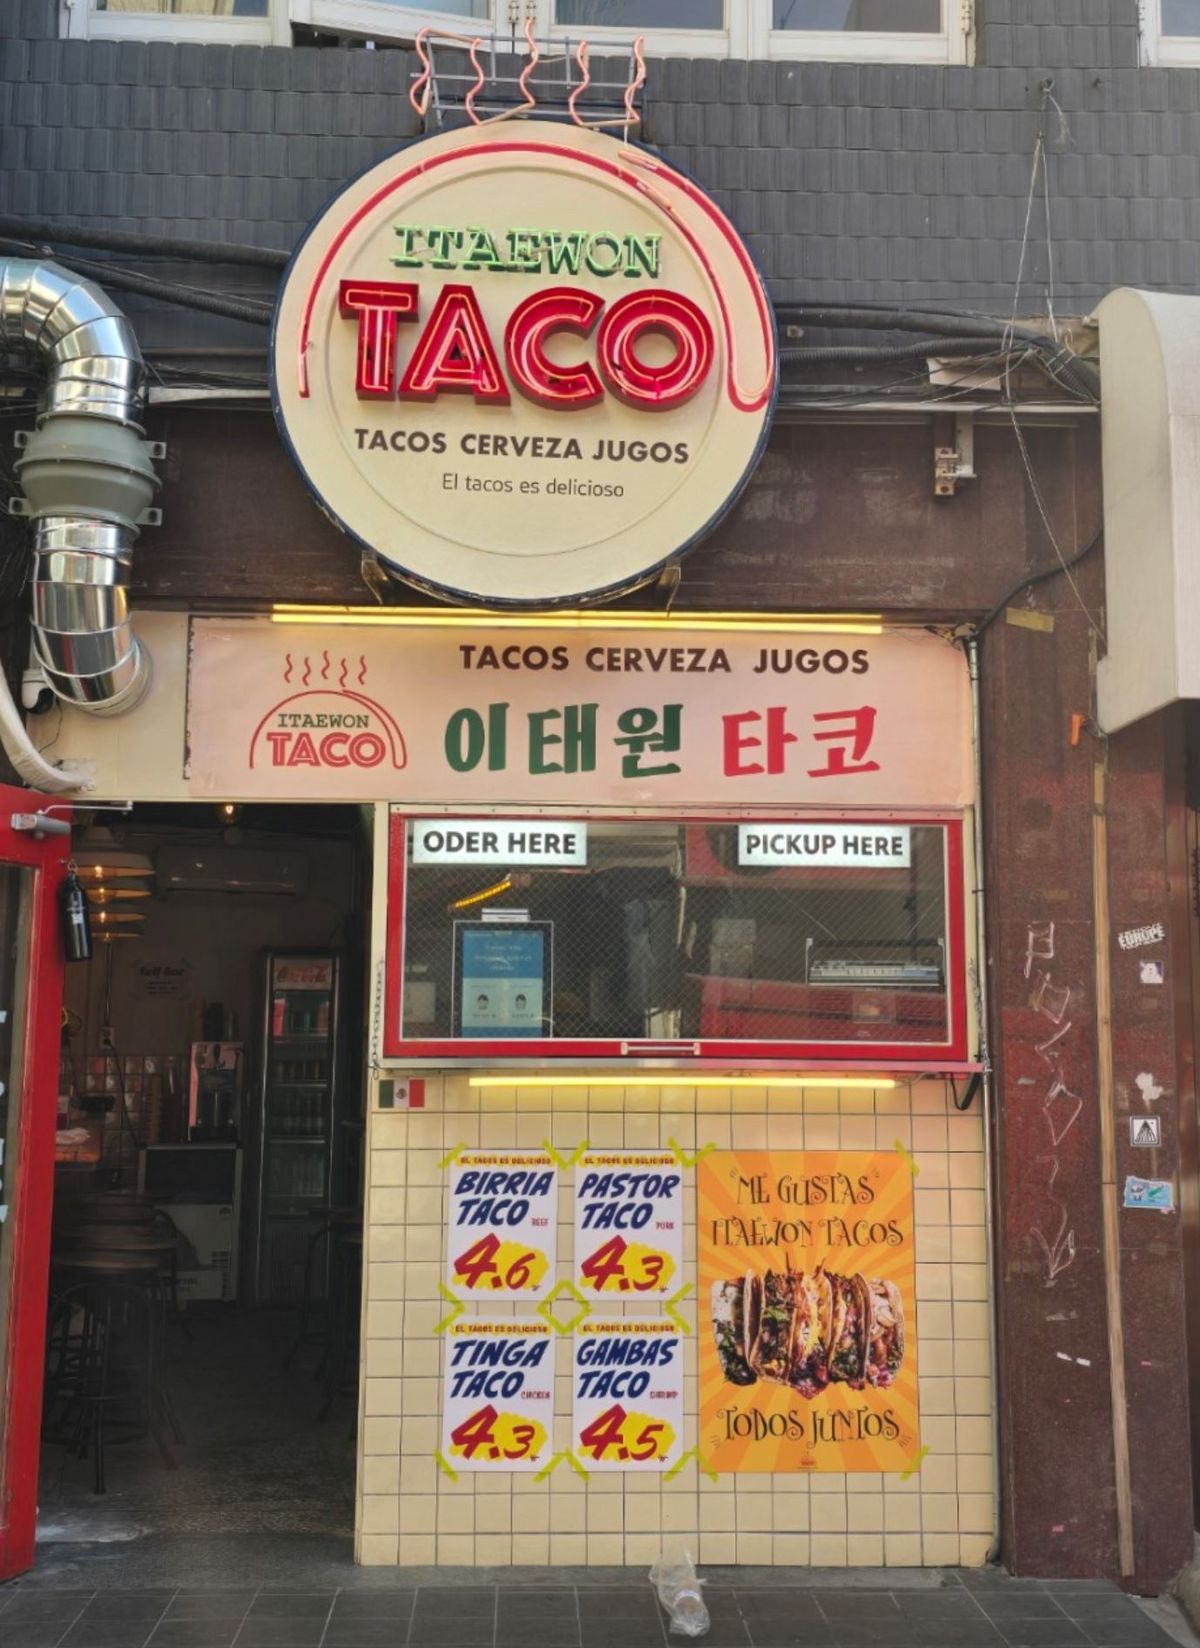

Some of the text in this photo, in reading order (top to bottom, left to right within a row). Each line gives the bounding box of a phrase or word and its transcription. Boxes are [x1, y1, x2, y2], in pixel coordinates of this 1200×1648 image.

[390, 225, 662, 278] ITAEWON
[339, 279, 715, 411] TACO
[355, 428, 689, 464] TACOS CERVEZA JUGOS
[442, 473, 624, 497] El tacos es delicioso
[460, 645, 869, 674] TACOS CERVEZA JUGOS
[277, 713, 370, 729] ITAEWON
[266, 731, 386, 768] TACO
[445, 702, 881, 778] 이태원 타코
[423, 830, 577, 855] ODER HERE
[746, 834, 904, 856] PICKUP HERE
[454, 1171, 555, 1196] BIRRIA
[578, 1173, 681, 1199] PASTOR
[737, 1172, 875, 1205] ME GUSTAS
[457, 1197, 530, 1226] TACO
[581, 1201, 654, 1229] TACO
[712, 1216, 904, 1248] ITAEWON TACOS
[454, 1232, 536, 1290] 4.6
[581, 1234, 664, 1292] 4.3
[450, 1339, 551, 1368] TINGA
[576, 1338, 679, 1366] GAMBAS
[450, 1369, 525, 1399] TACO
[577, 1369, 650, 1399] TACO
[451, 1404, 535, 1460] 4.3
[579, 1403, 664, 1461] 4.5
[717, 1405, 900, 1449] TODOS JUNTOS
